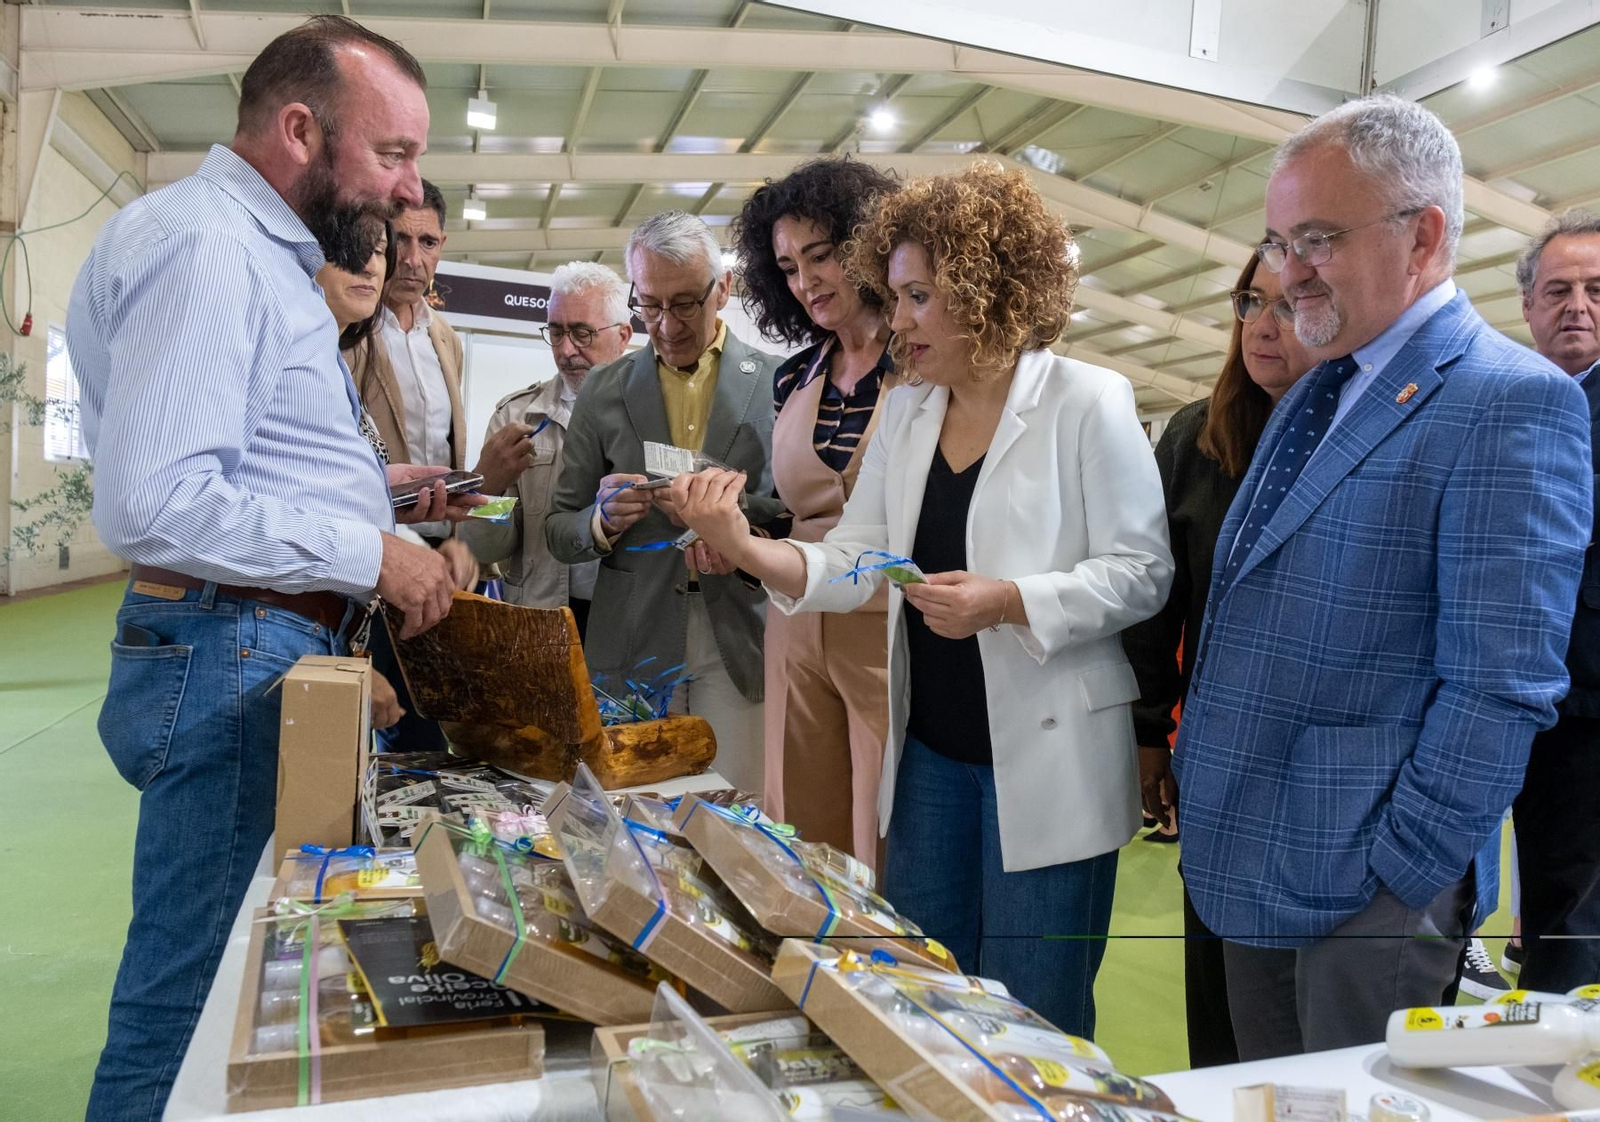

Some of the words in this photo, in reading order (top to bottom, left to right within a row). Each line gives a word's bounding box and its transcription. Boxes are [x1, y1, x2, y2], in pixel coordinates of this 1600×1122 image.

[387, 973, 466, 984] Oliva
[399, 992, 500, 1005] Provincial
[454, 1001, 504, 1010] Feria
